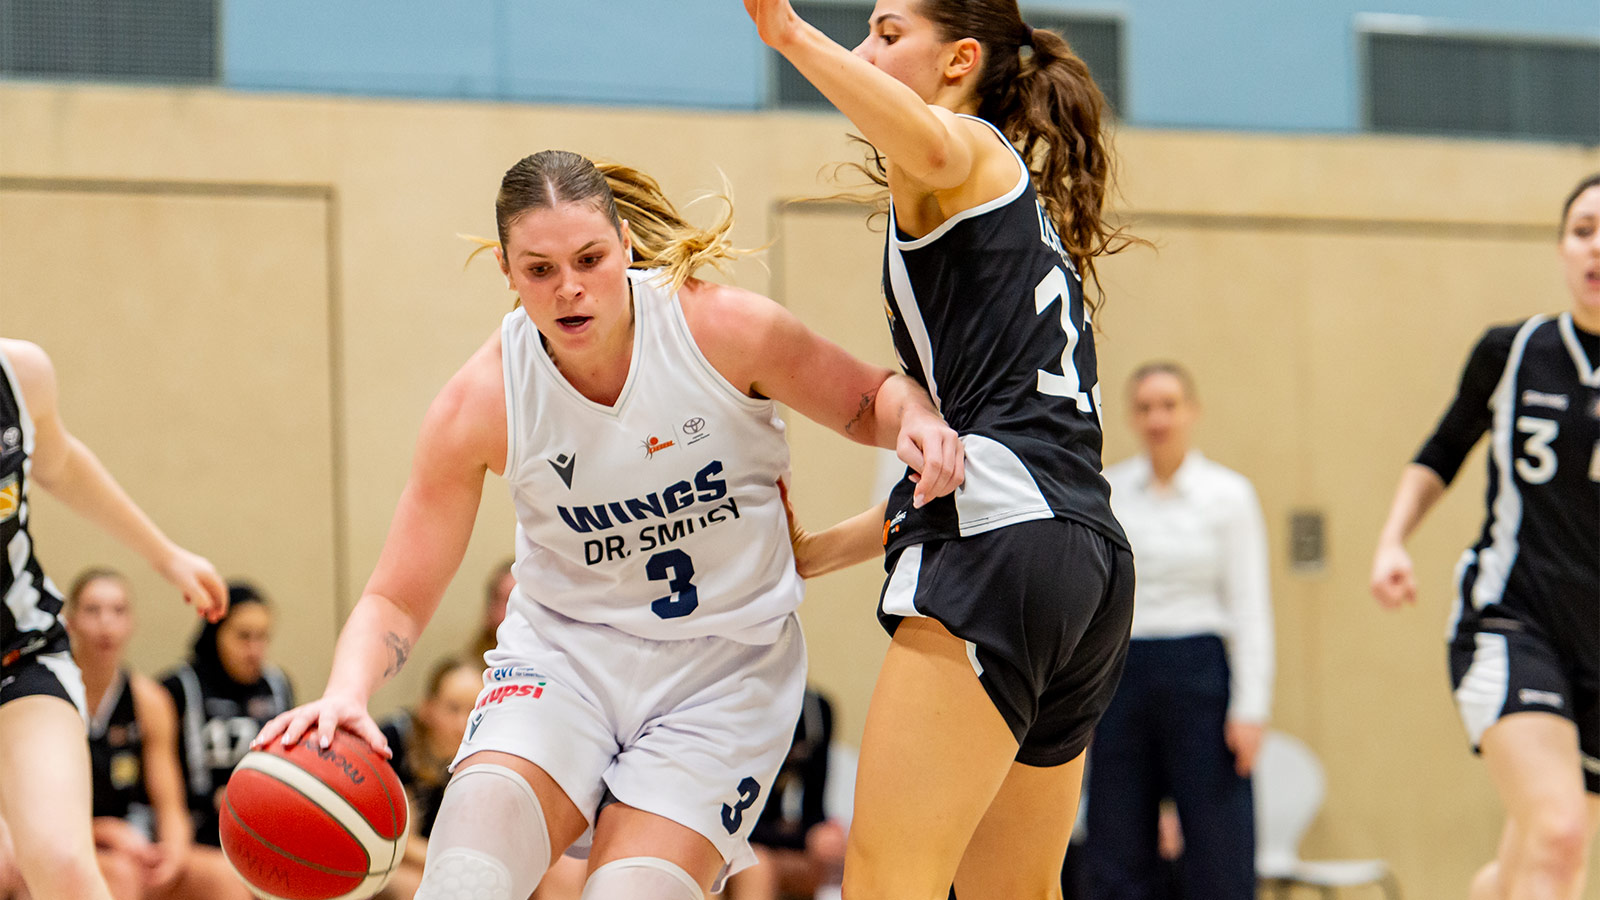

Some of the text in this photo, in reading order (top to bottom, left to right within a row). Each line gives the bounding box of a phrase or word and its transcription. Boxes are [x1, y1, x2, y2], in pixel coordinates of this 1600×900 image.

[1515, 415, 1560, 485] 3
[557, 460, 728, 533] WINGS
[584, 534, 632, 566] DR.
[645, 548, 699, 620] 3
[720, 775, 761, 835] 3
